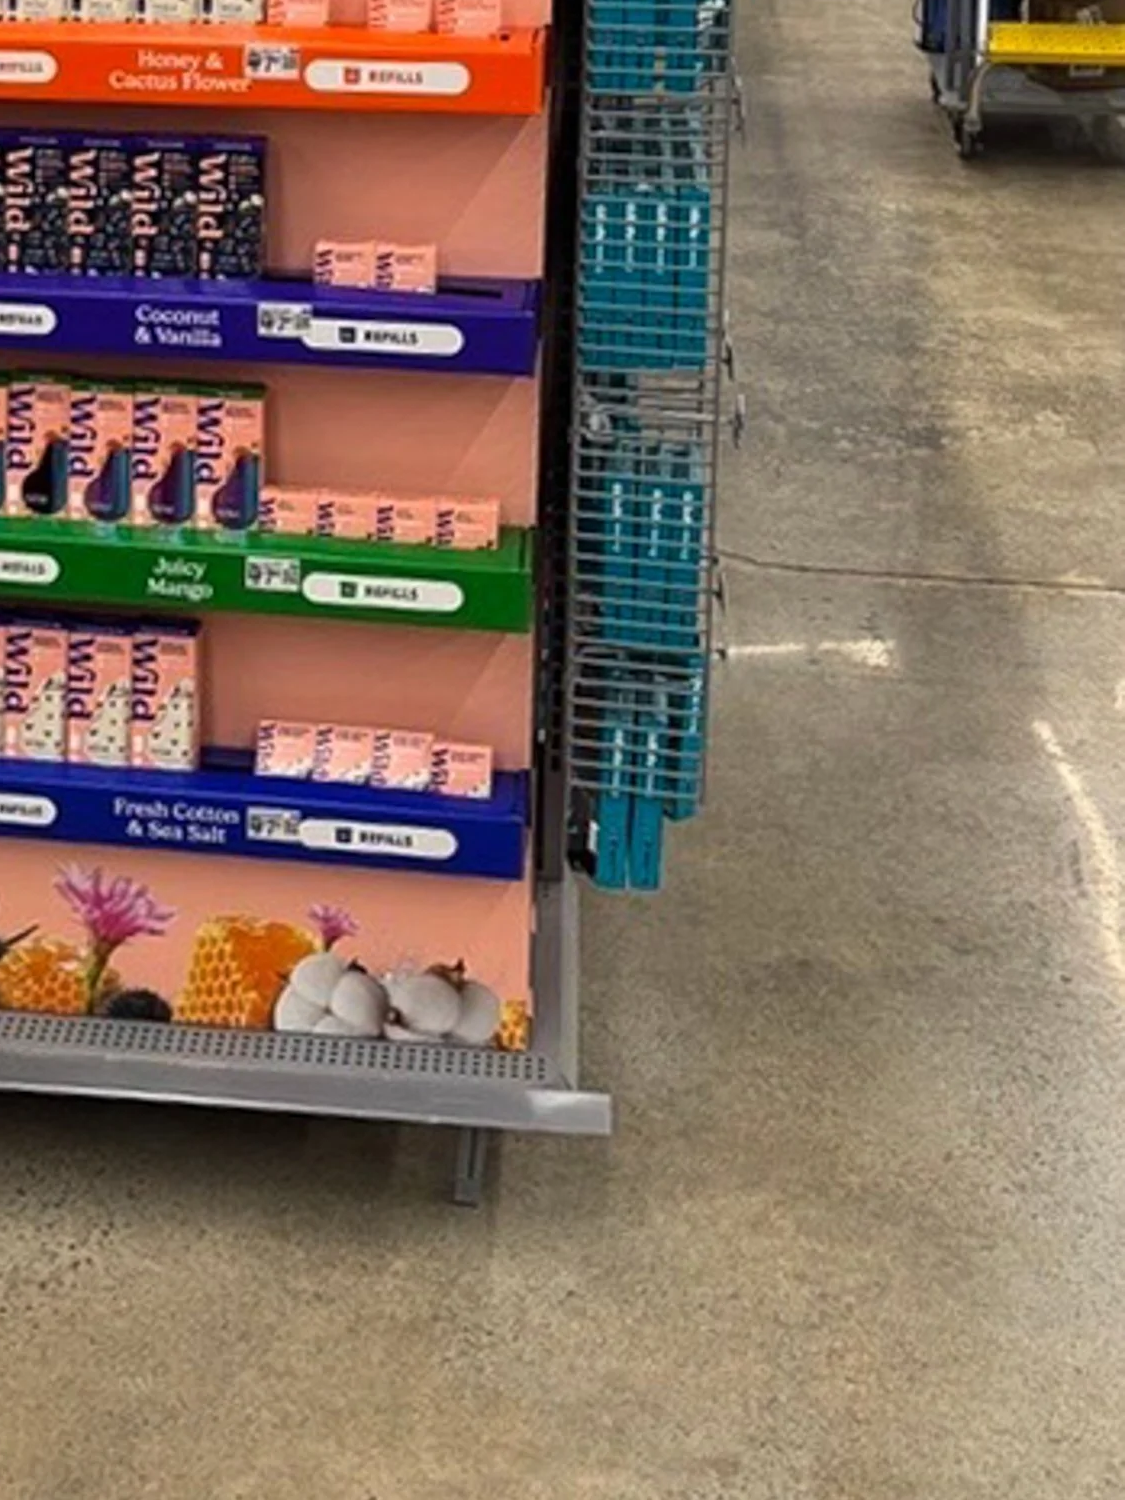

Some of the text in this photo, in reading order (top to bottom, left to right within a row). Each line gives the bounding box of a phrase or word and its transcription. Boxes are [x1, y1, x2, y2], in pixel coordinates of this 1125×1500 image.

[137, 48, 202, 75] Honey
[205, 51, 224, 71] &
[108, 69, 253, 93] Cactus Flower
[367, 69, 425, 86] REFILLS
[5, 146, 34, 231] Wild
[68, 148, 97, 235] Wild
[133, 150, 162, 237] Wild
[198, 152, 227, 240] Wild
[134, 303, 221, 327] Coconut
[134, 325, 223, 348] & Vanilla
[362, 328, 420, 346] REFILLS
[6, 384, 36, 470] Wild
[69, 393, 97, 478] Wild
[133, 396, 162, 480] Wild
[196, 400, 225, 486] Wild
[151, 555, 208, 581] Juicy
[146, 577, 215, 602] Mango
[362, 584, 420, 602] REFILLS
[4, 631, 33, 714] Wild
[67, 638, 98, 720] Wild
[131, 639, 161, 722] Wild
[112, 796, 169, 820] Fresh
[172, 802, 241, 825] Cotton
[126, 819, 144, 838] &
[148, 819, 184, 841] Sea
[186, 822, 228, 845] Salt
[359, 829, 414, 848] REFILLS
